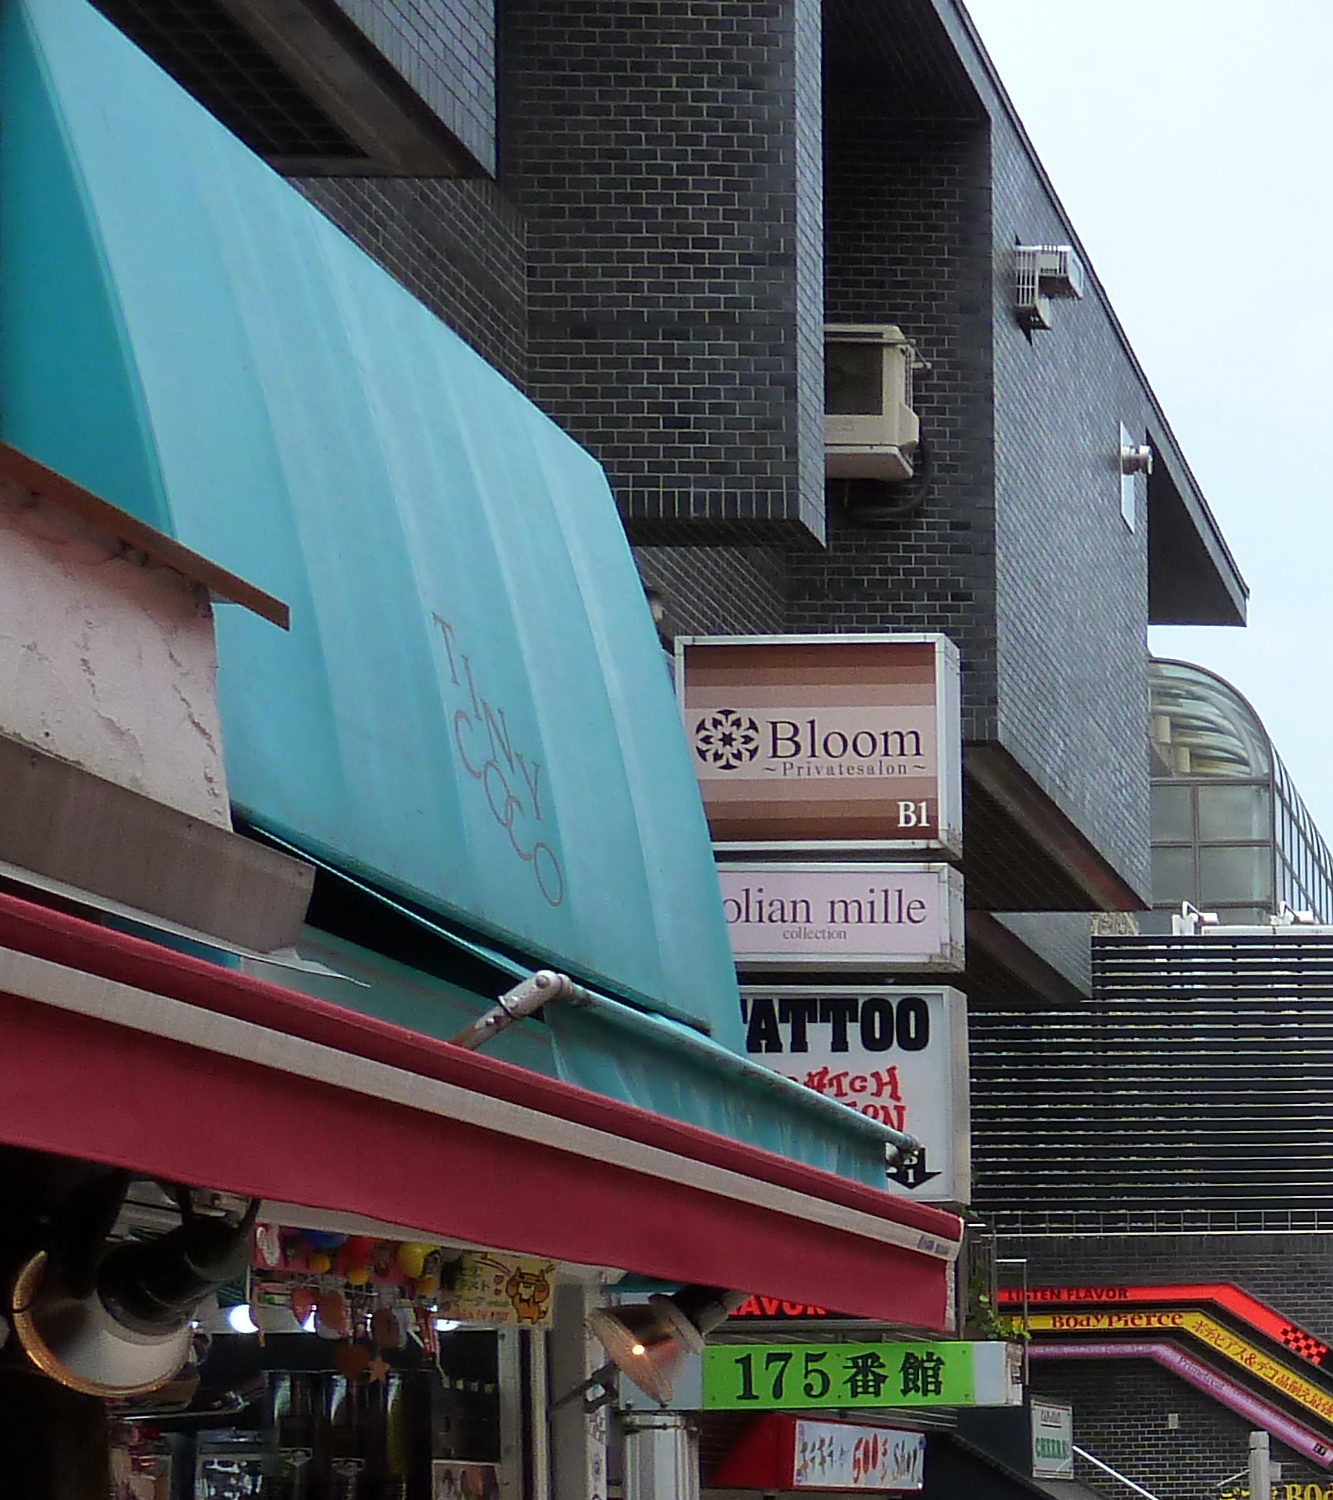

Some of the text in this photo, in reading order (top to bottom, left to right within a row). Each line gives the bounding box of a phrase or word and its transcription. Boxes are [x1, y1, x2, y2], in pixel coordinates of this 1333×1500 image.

[767, 719, 924, 759] Bloom
[897, 801, 930, 828] B1
[827, 887, 926, 925] mille
[783, 926, 847, 941] collection
[740, 997, 930, 1053] ATTOO
[1067, 1288, 1128, 1300] FLAVOR
[734, 1351, 946, 1400] 175番館
